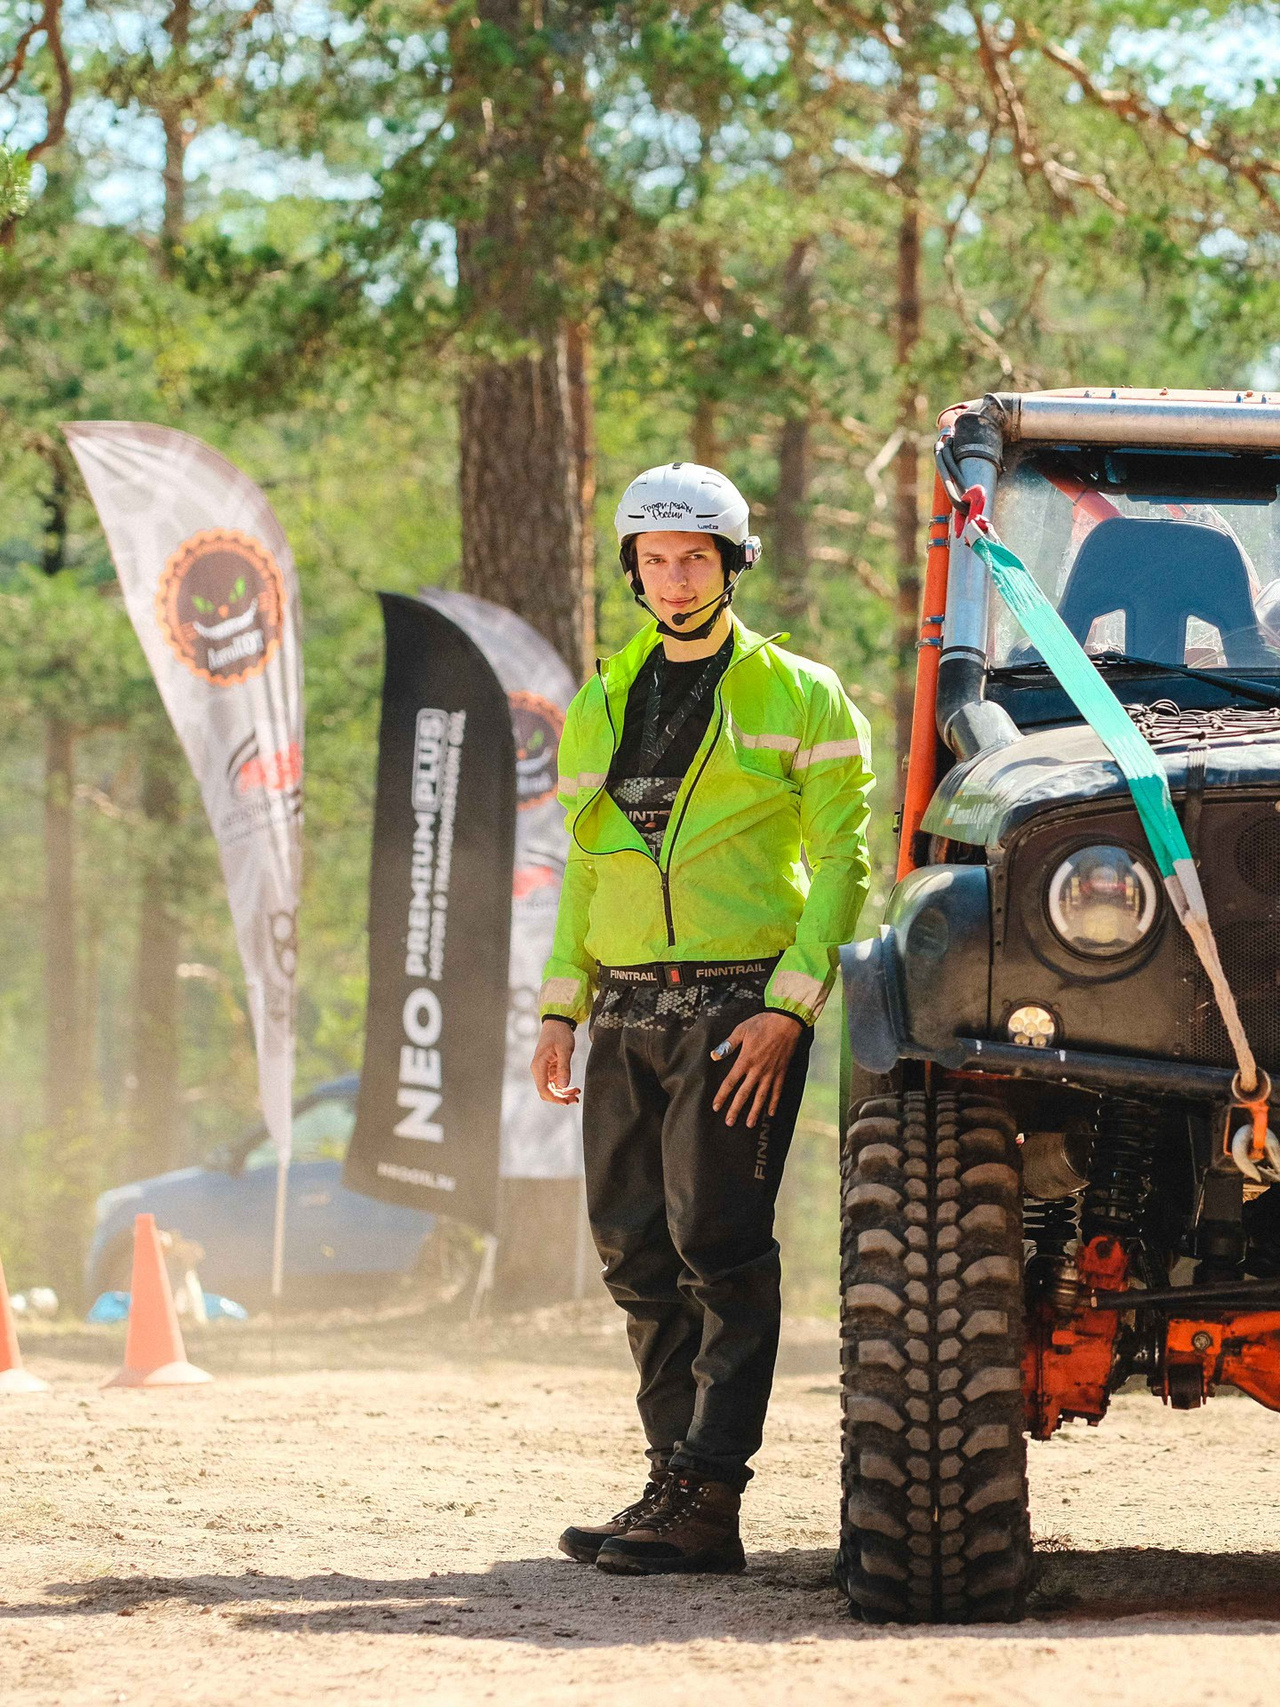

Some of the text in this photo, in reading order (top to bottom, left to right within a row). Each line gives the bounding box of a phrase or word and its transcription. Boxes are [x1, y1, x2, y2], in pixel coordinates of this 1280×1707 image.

[405, 712, 443, 979] PREMIUM PLUS
[610, 969, 657, 980] FINNTRAIL
[696, 965, 766, 978] FINNTRAIL
[393, 988, 443, 1143] NEO
